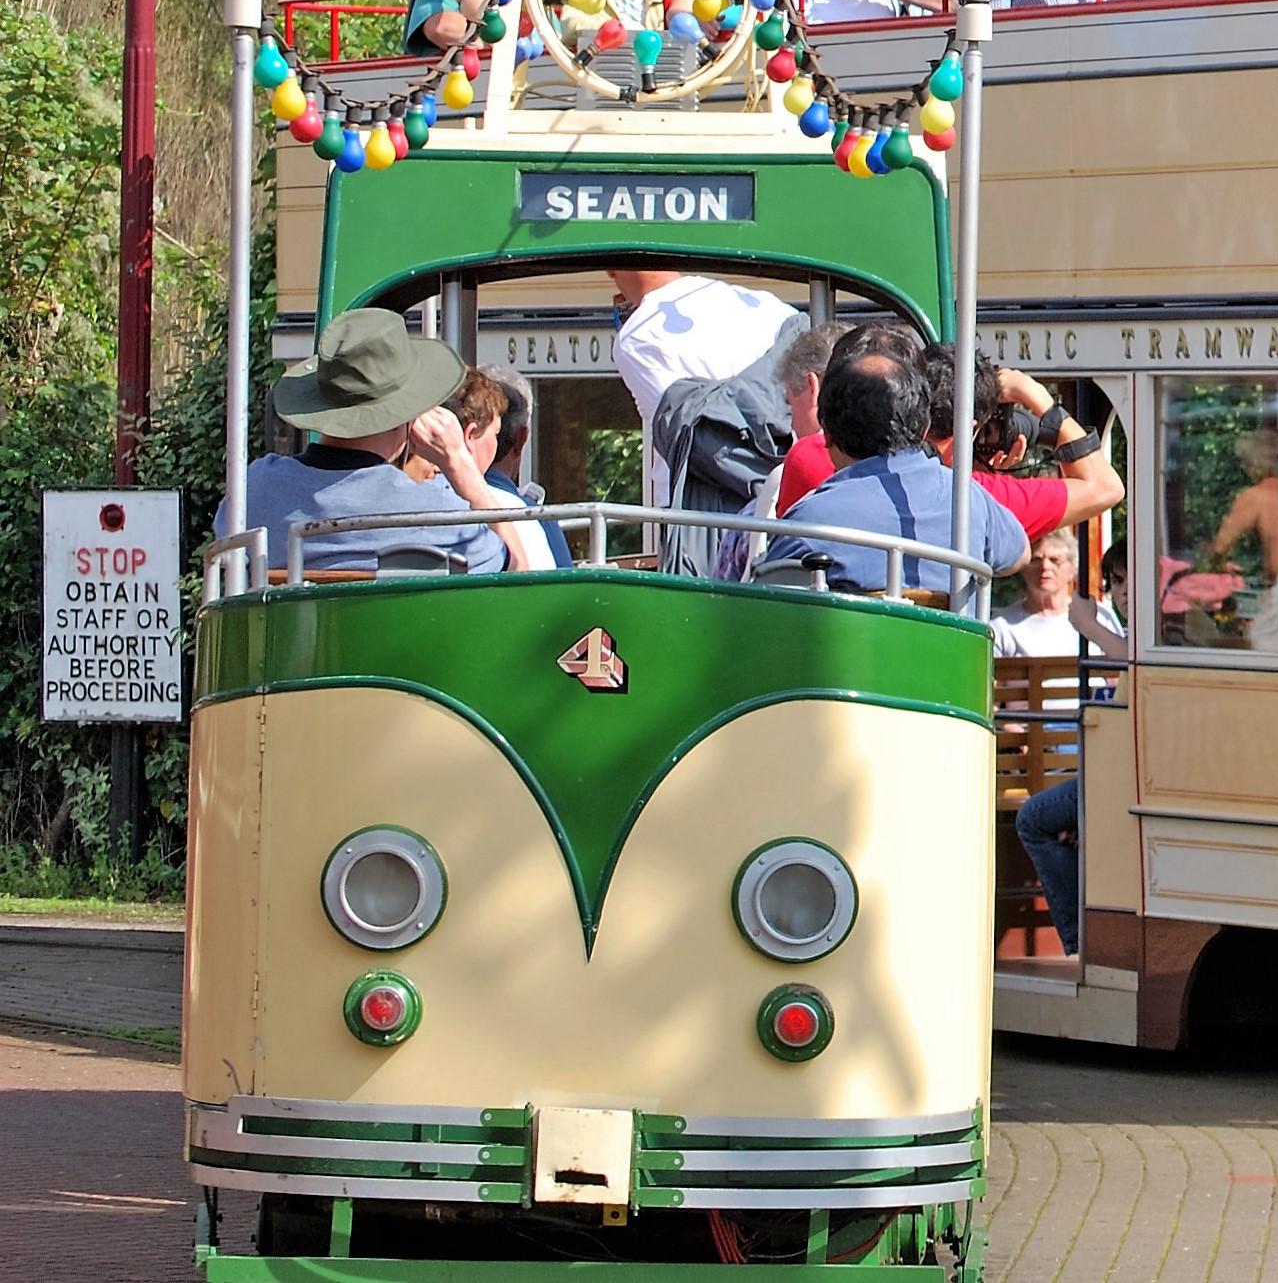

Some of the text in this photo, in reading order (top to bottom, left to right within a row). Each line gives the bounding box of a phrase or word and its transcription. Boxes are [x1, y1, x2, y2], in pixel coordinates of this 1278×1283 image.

[545, 185, 728, 221] SEATON
[976, 329, 1077, 360] TRIC
[77, 548, 147, 575] STOP
[66, 581, 160, 603] OBTAIN
[56, 609, 169, 629] STAFF OR
[48, 635, 178, 656] AUTHORITY
[70, 659, 155, 679] BEFORE
[557, 626, 628, 694] 4
[46, 682, 180, 702] PROCEEDING
